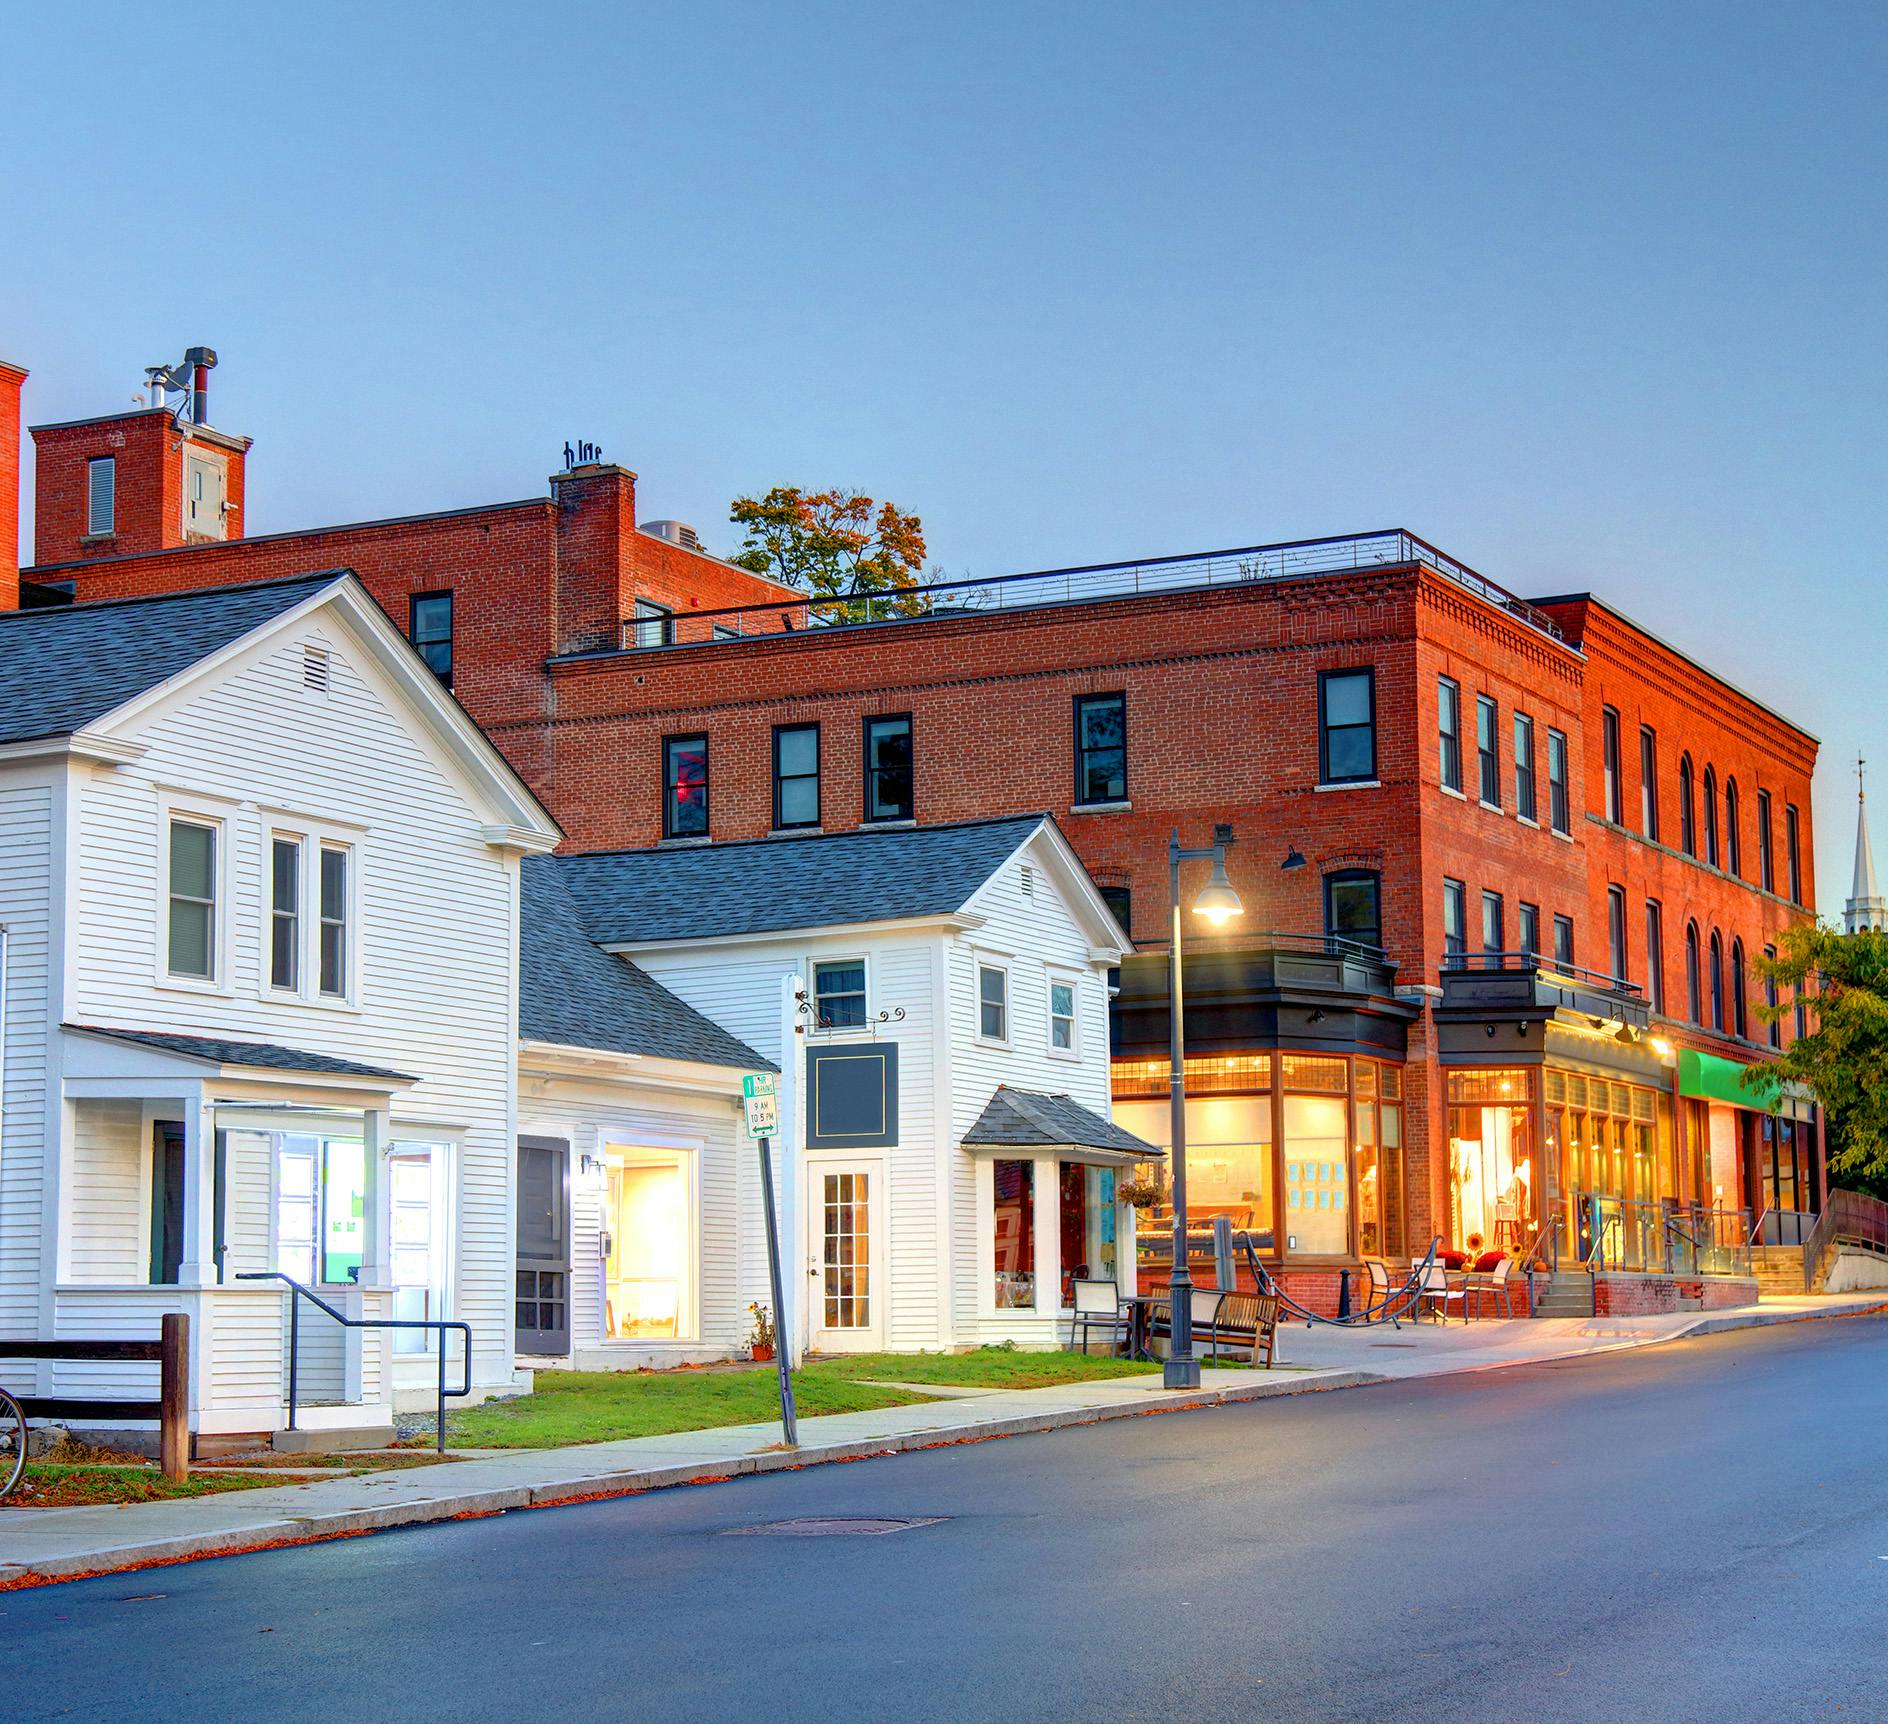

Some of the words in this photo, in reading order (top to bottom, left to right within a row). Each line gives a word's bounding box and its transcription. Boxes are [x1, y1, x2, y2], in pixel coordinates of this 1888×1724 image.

[747, 1080, 752, 1095] 1
[754, 1102, 758, 1111] 9
[760, 1101, 768, 1110] AM
[760, 1113, 765, 1122] 5
[766, 1112, 774, 1121] PM
